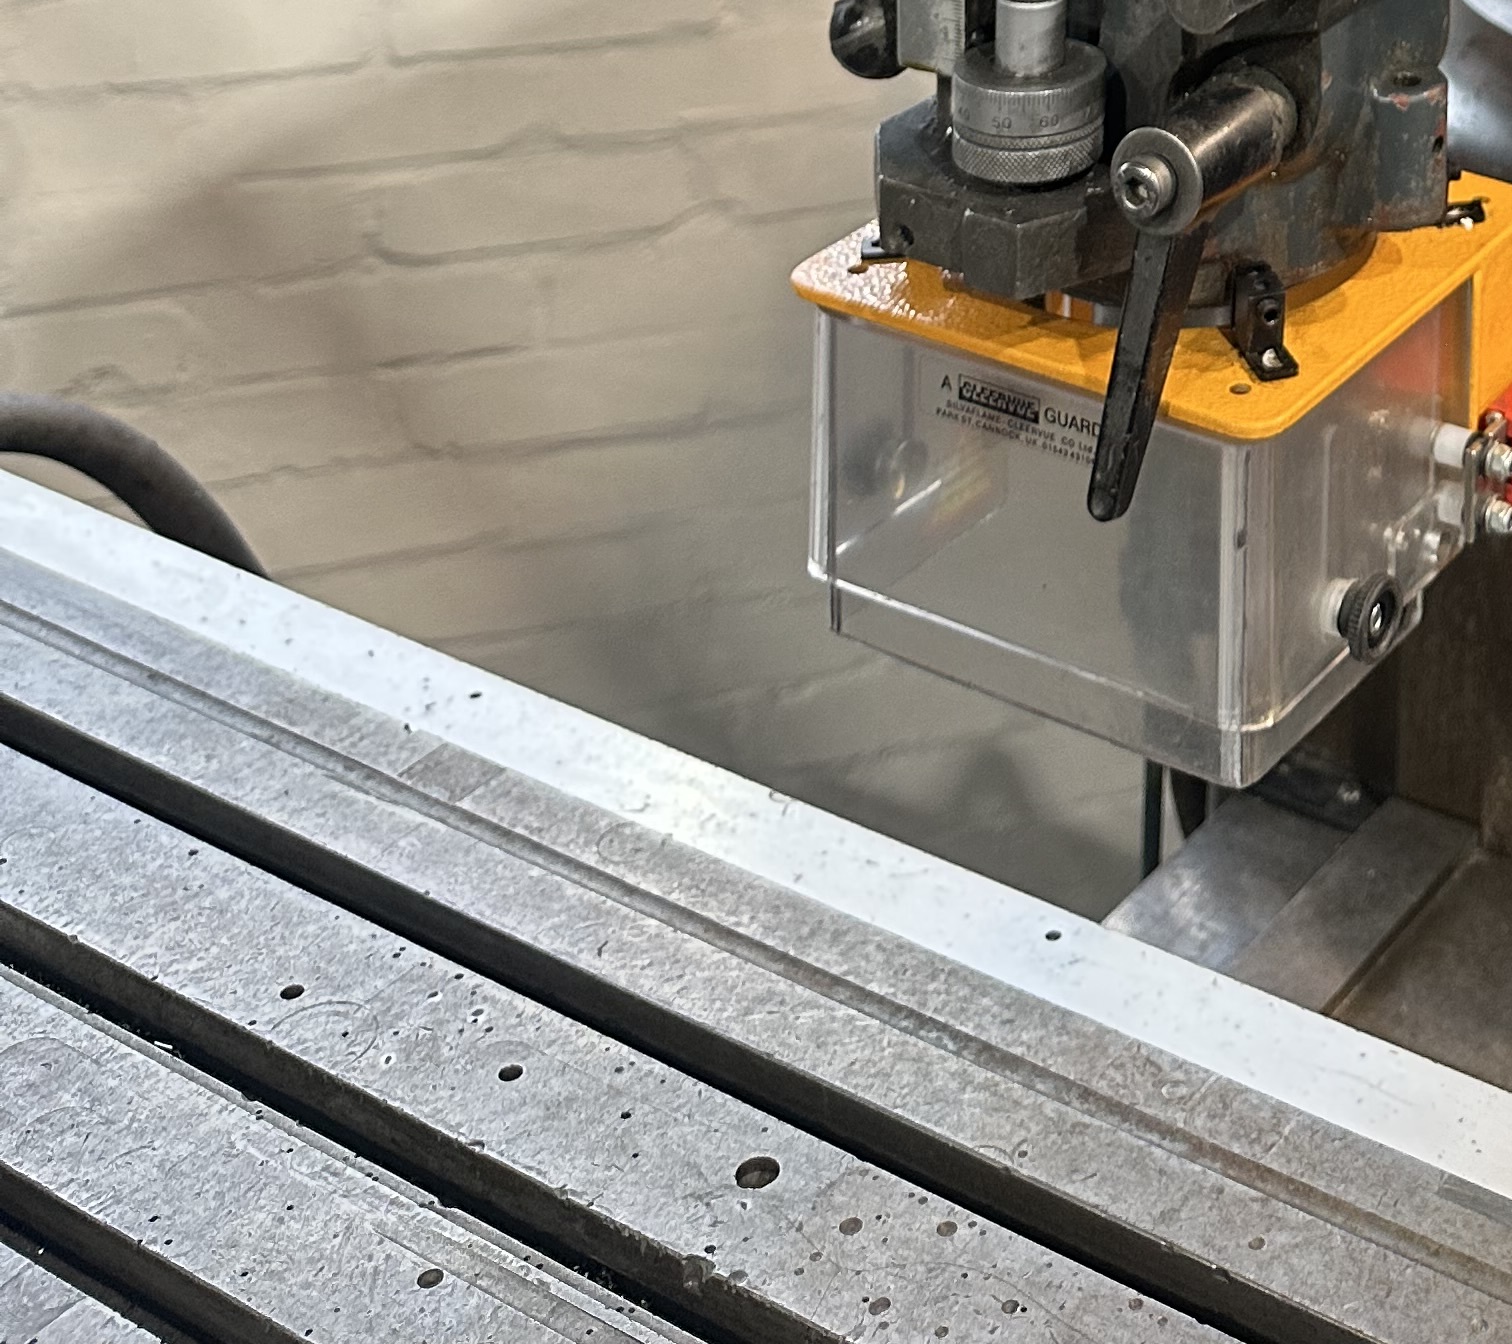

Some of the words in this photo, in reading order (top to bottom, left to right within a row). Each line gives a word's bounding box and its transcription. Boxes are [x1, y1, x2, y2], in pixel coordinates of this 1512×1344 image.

[992, 116, 1012, 130] 50
[1039, 114, 1060, 129] 60
[941, 374, 952, 391] A
[1044, 406, 1100, 437] GUARD
[1061, 436, 1075, 449] CO
